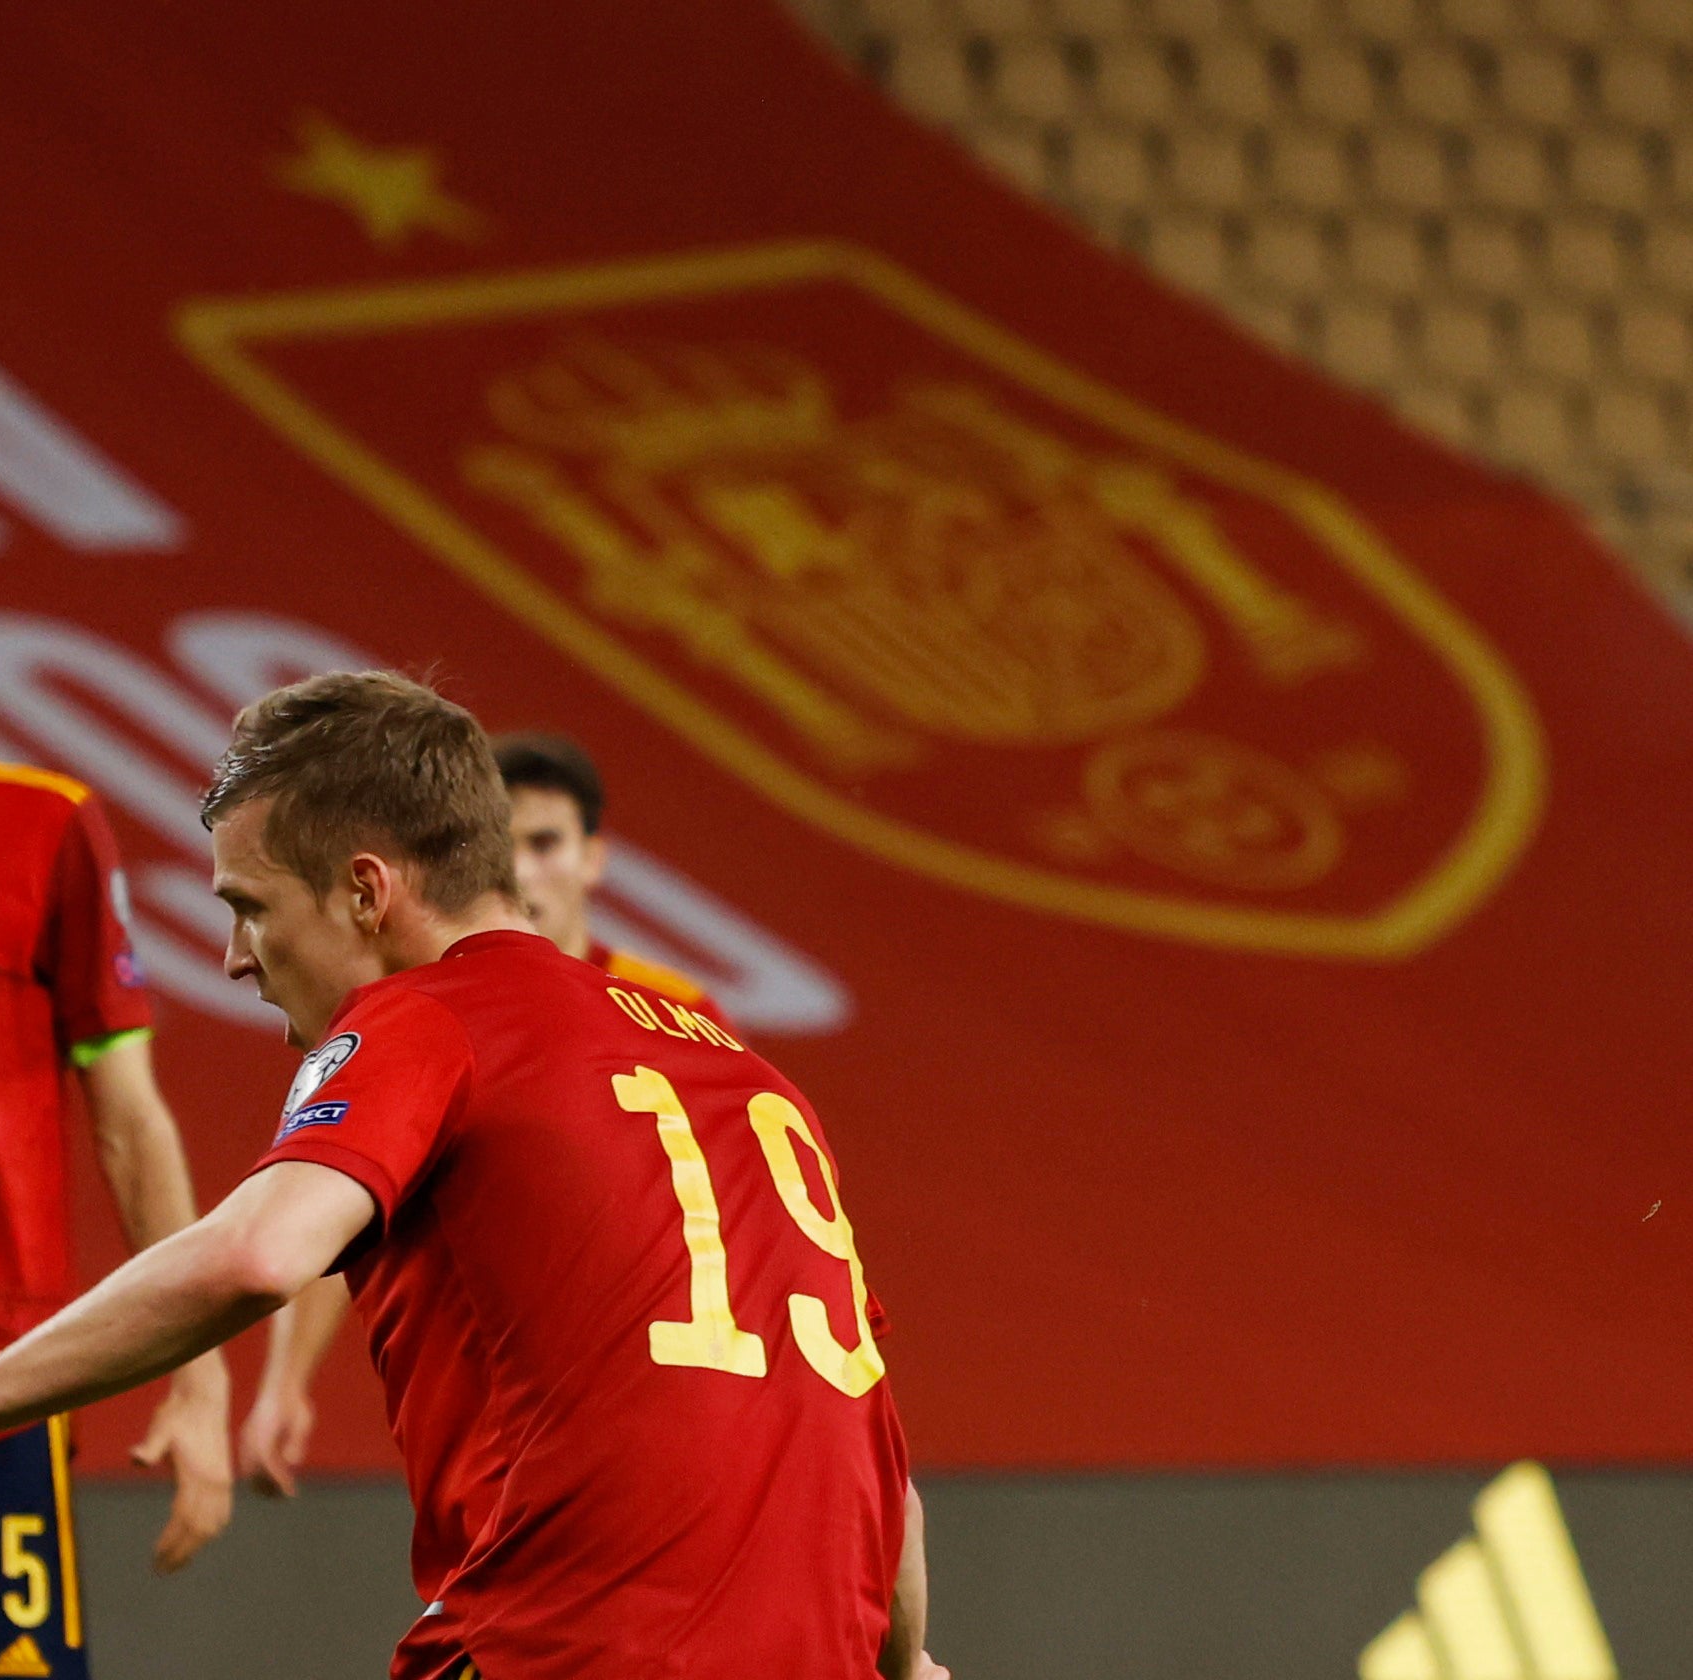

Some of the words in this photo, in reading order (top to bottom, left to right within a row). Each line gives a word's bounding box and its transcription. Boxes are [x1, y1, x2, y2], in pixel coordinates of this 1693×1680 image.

[605, 985, 746, 1053] OLMO
[611, 1064, 886, 1399] 19
[0, 1514, 52, 1629] 5
